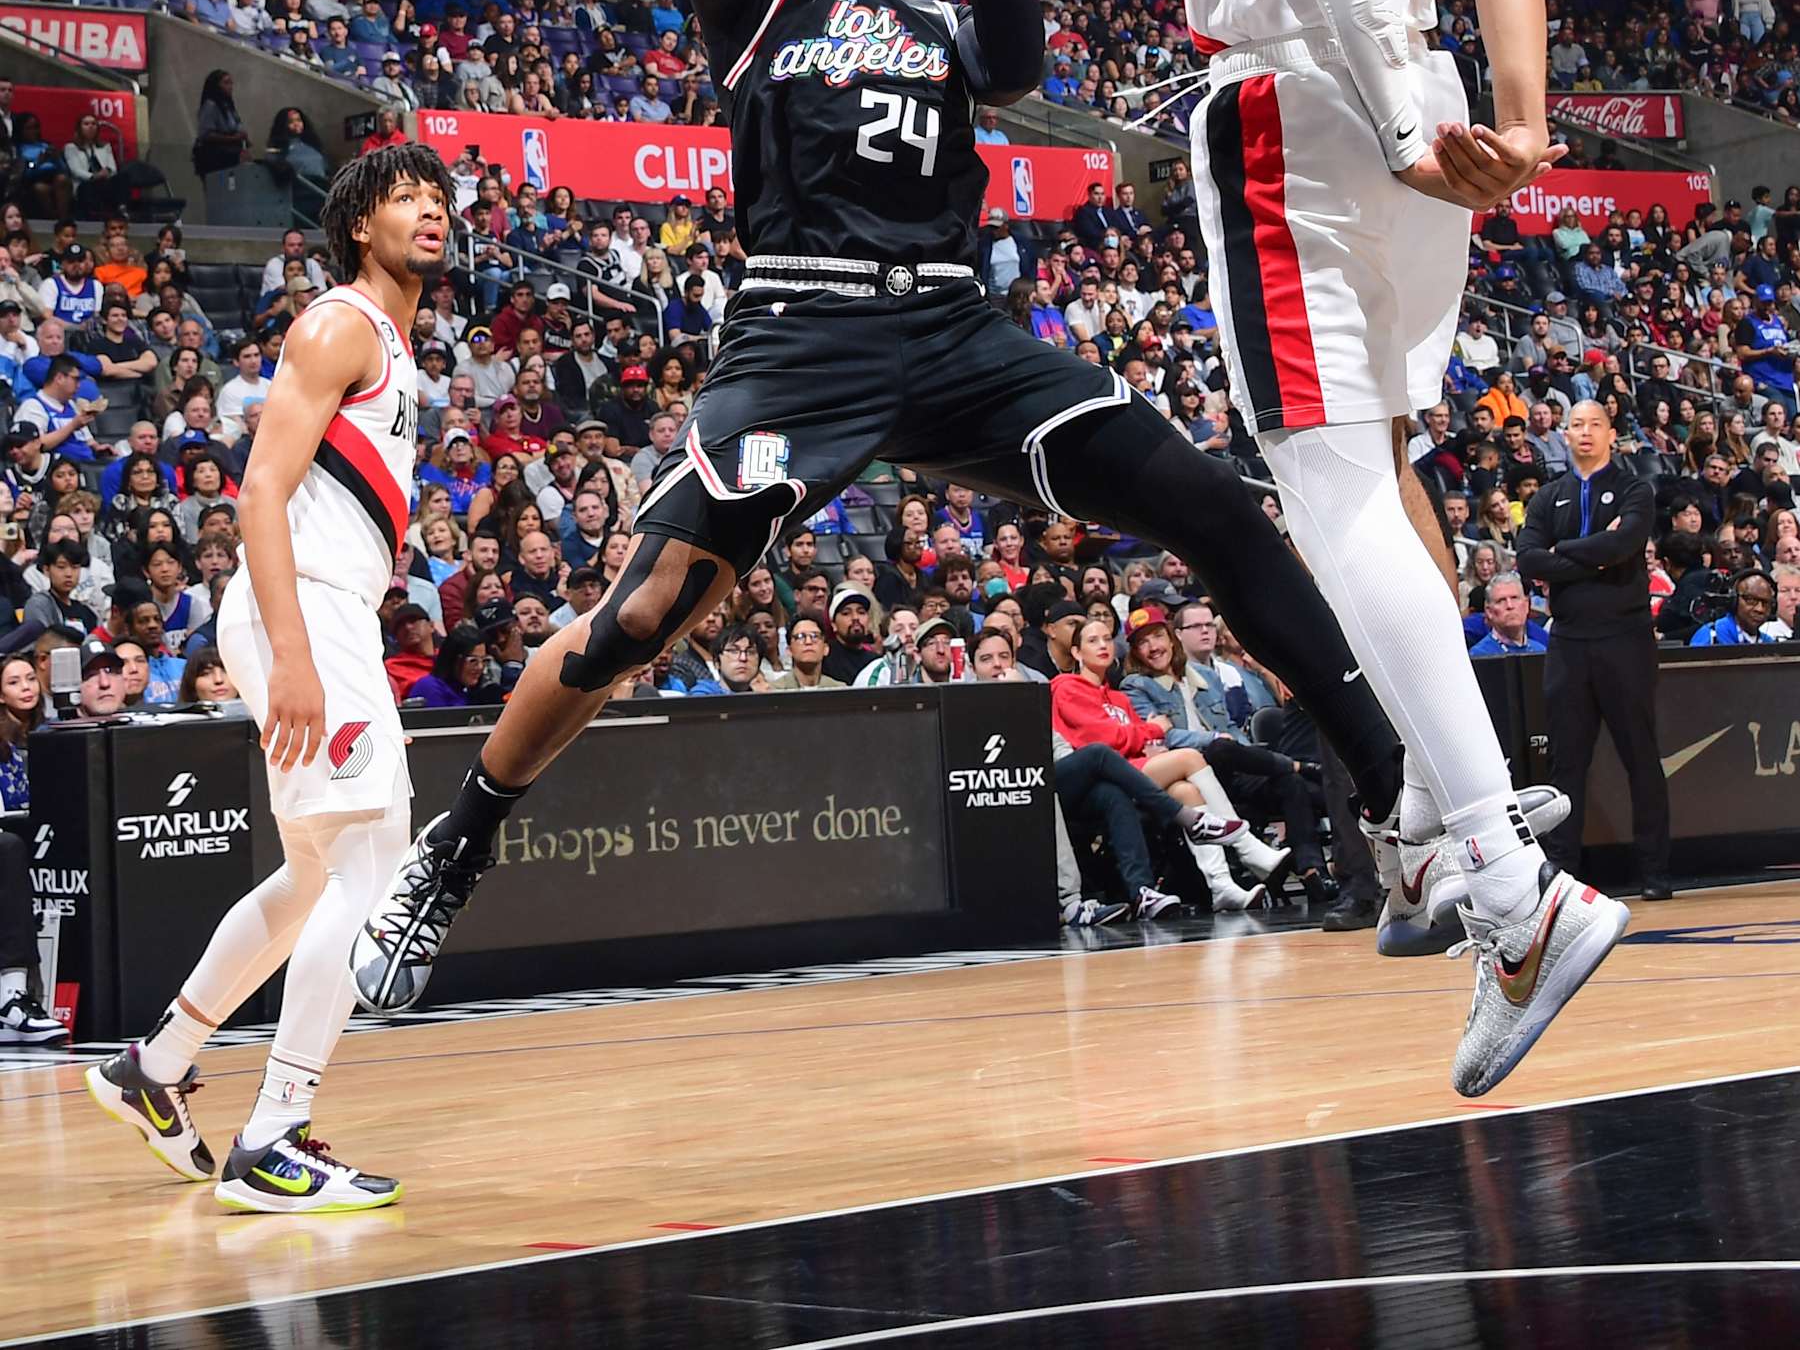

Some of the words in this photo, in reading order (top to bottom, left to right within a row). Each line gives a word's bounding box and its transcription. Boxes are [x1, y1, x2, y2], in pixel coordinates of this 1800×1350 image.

[0, 16, 142, 65] SHIBA
[771, 34, 949, 86] angeles
[91, 98, 124, 118] 101
[1550, 96, 1648, 135] Coca-Cola
[425, 116, 459, 135] 102
[855, 87, 939, 177] 24
[633, 144, 734, 191] CLIP
[1083, 153, 1108, 170] 102
[1687, 175, 1710, 191] 103
[1511, 186, 1616, 222] Clippers
[949, 766, 1045, 791] STARLUX
[966, 790, 1032, 808] AIRLINES
[117, 808, 250, 841] STARLUX
[496, 817, 634, 875] Hoops
[646, 807, 680, 853] is
[693, 808, 800, 850] never
[812, 794, 910, 843] done.
[140, 836, 230, 859] AIRLINES
